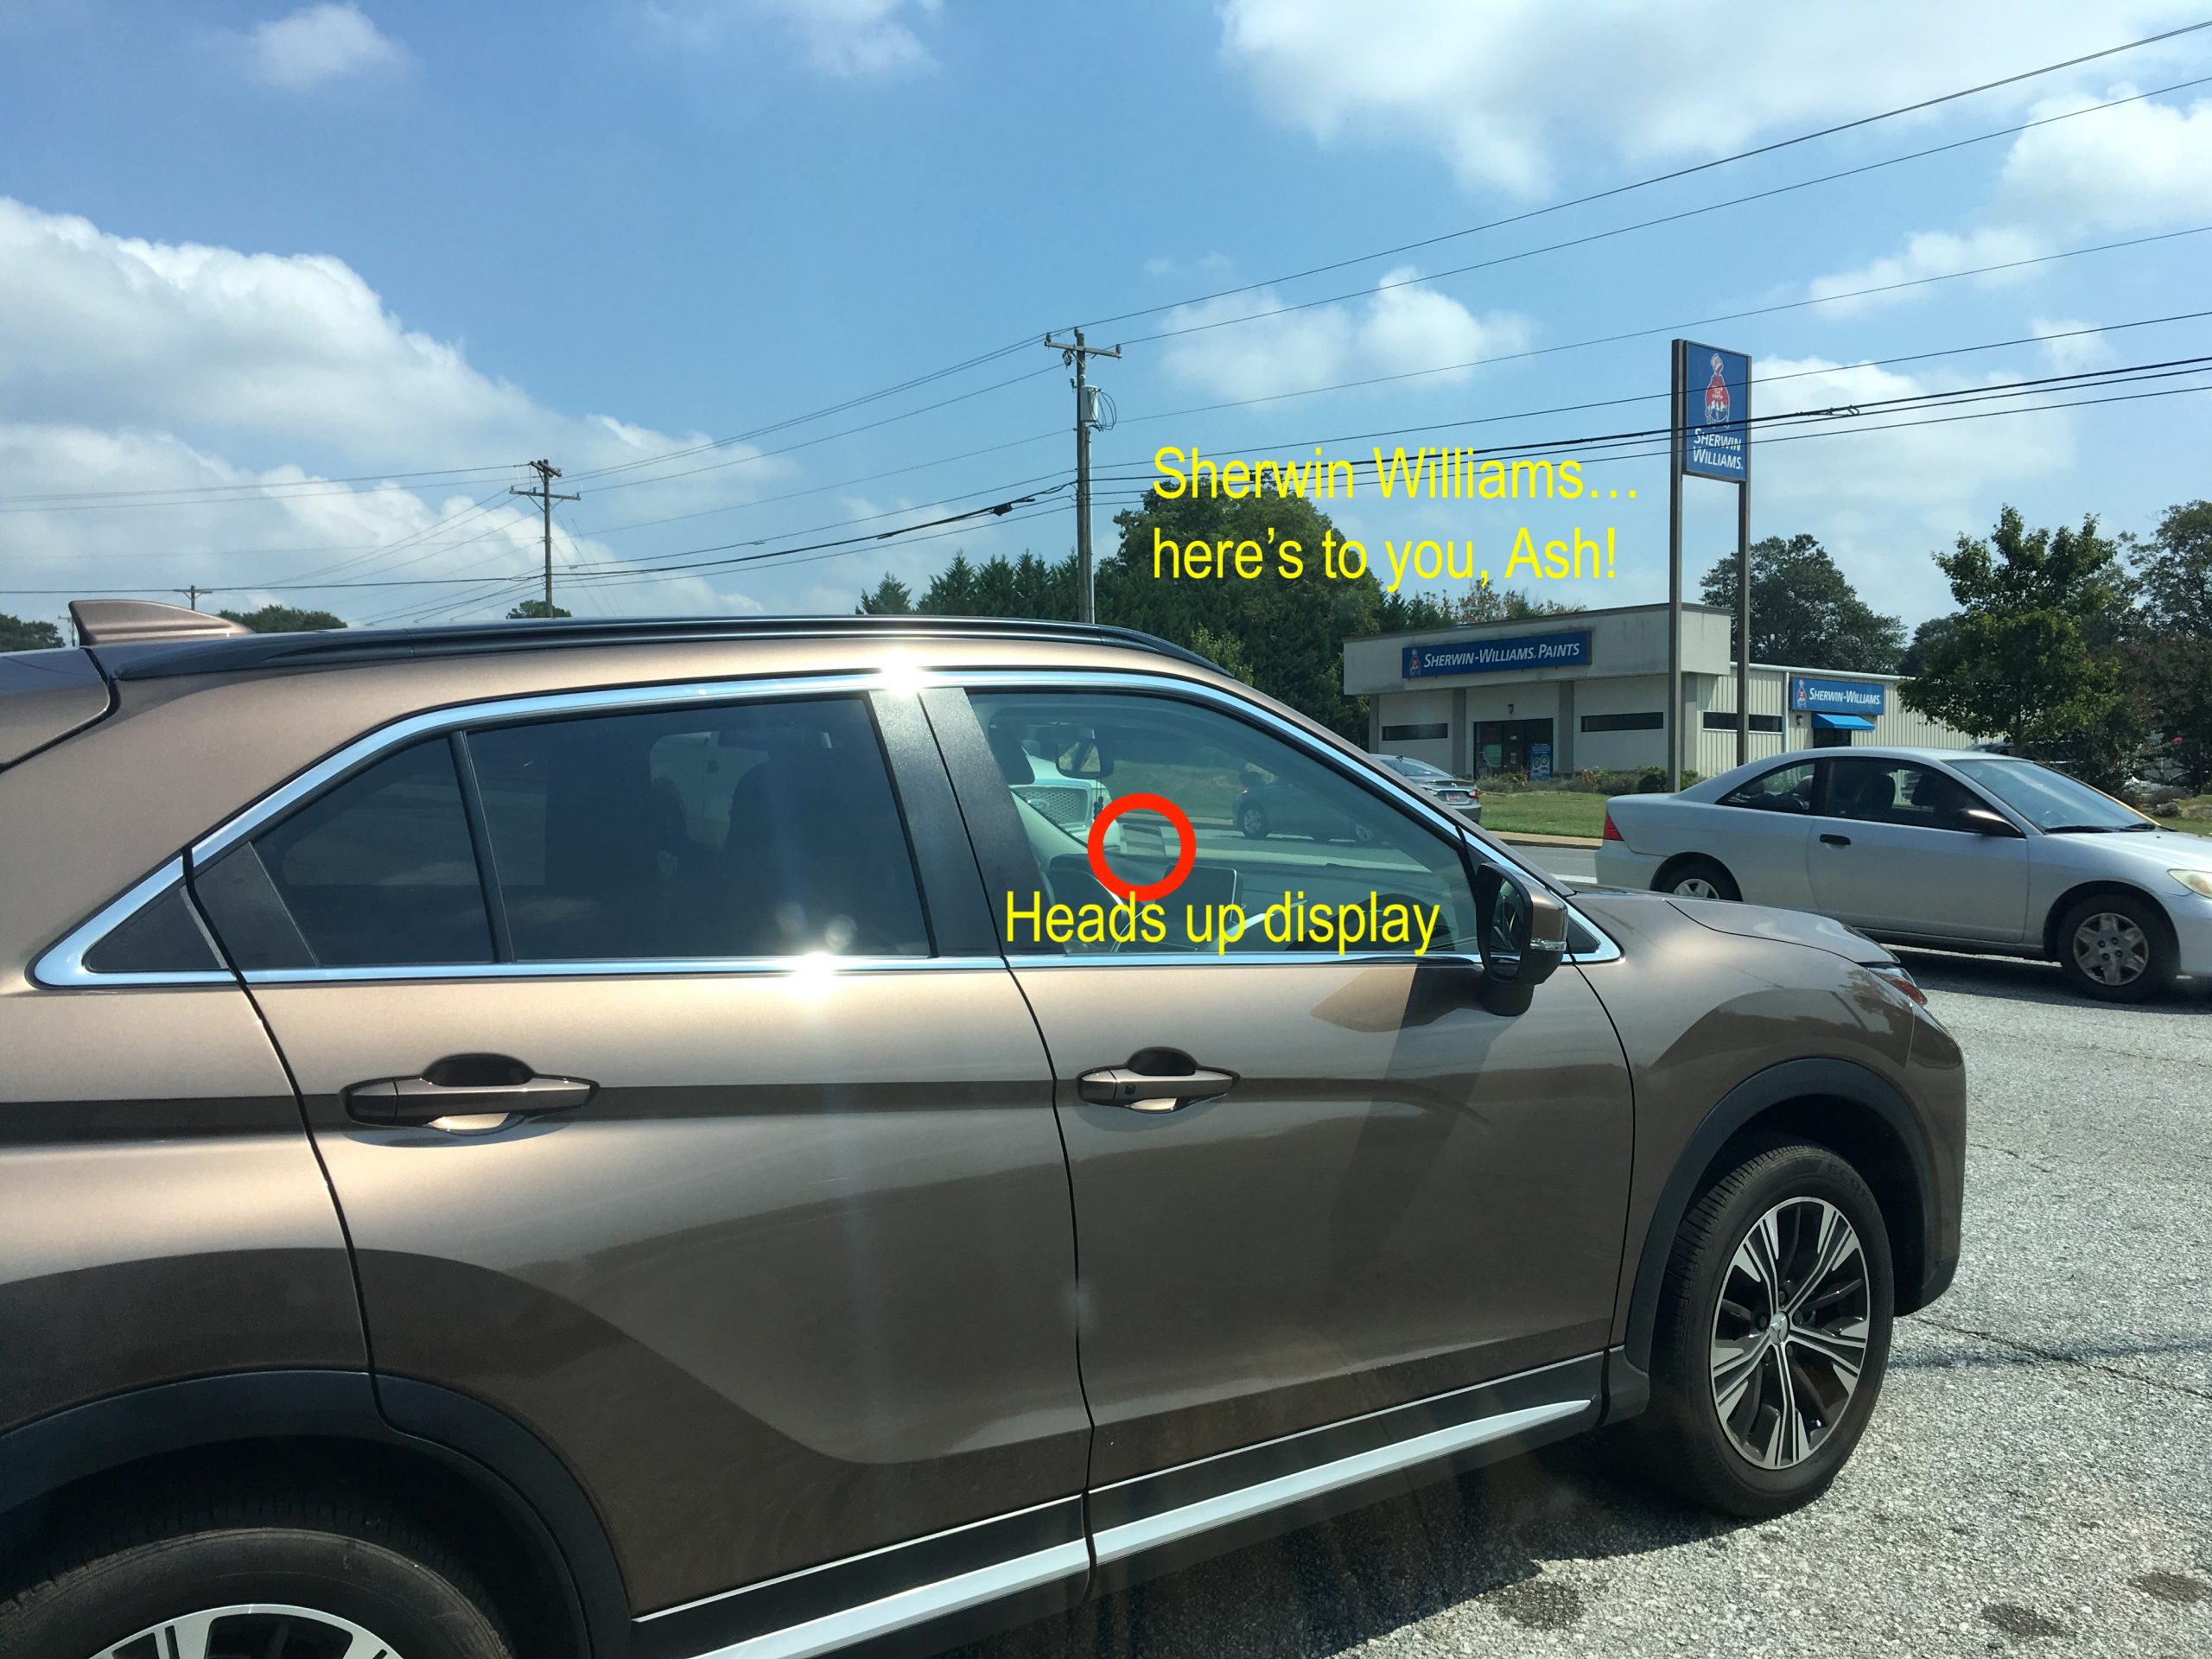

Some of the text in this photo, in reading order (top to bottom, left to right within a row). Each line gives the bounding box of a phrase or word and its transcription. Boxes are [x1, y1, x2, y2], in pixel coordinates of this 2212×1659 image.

[1694, 428, 1742, 451] SHERWIN
[1693, 445, 1742, 470] WILLIAMS
[1538, 643, 1580, 658] PAINTS
[1808, 687, 1881, 705] SHERWIN-WILLIAMS
